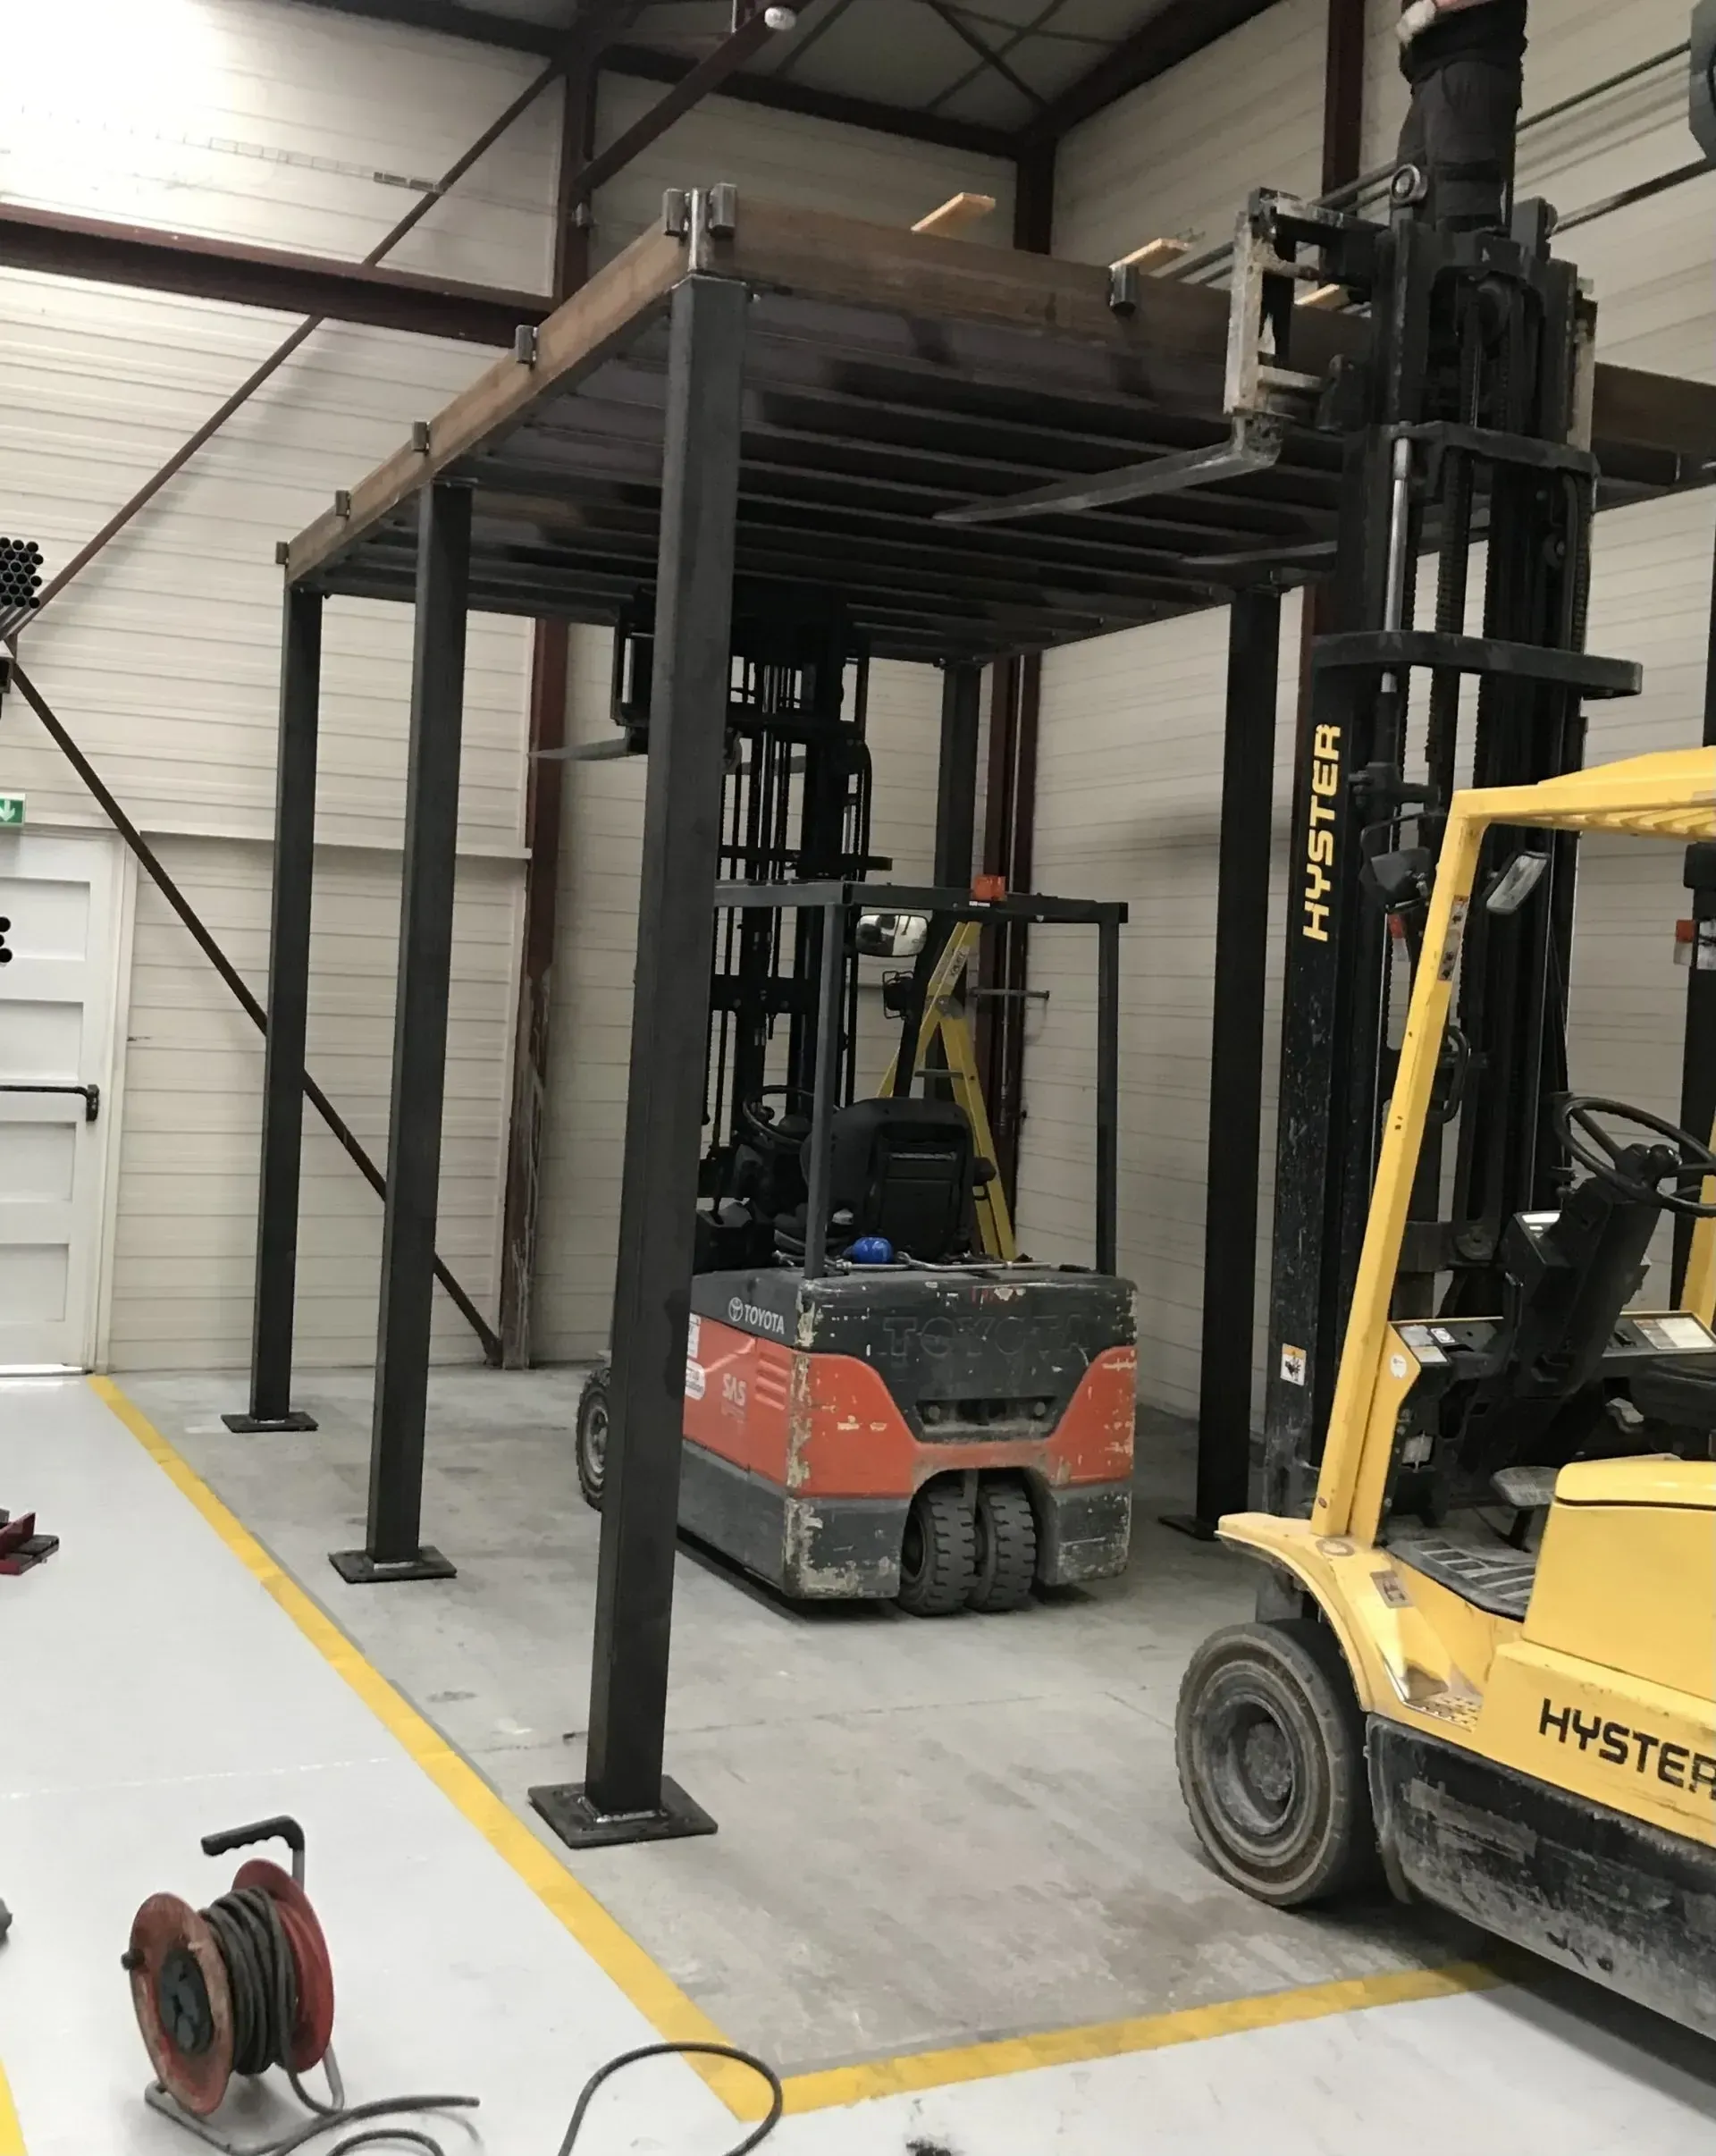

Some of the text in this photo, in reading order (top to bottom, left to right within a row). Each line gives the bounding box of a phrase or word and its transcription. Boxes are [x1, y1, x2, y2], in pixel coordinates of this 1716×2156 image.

[1302, 723, 1342, 941] HYSTER
[744, 1304, 785, 1335] TOYOTA
[1539, 1697, 1716, 1800] HYSTER
